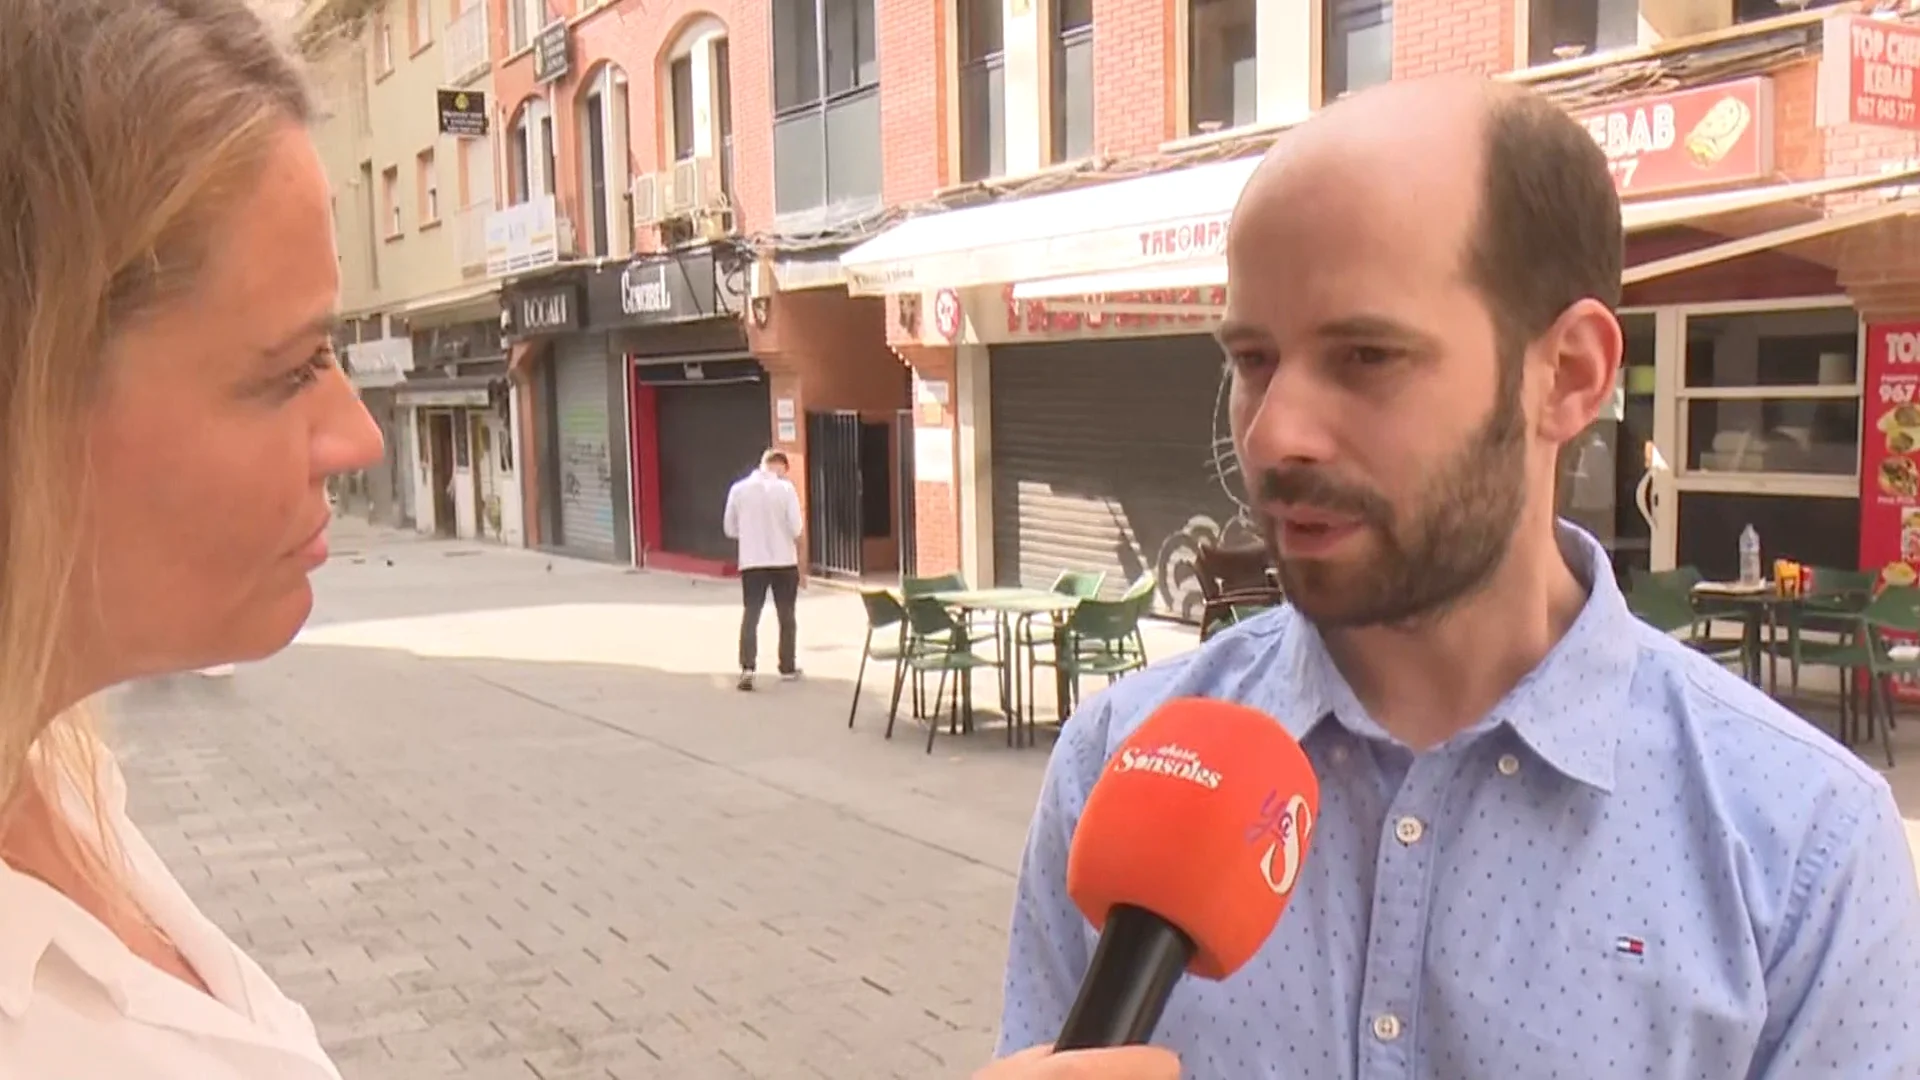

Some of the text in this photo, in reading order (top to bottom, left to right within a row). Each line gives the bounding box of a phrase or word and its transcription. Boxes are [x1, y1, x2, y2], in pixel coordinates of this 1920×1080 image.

[1852, 25, 1884, 61] TOP
[1863, 61, 1914, 99] KEBAB
[1580, 104, 1676, 158] EBAB
[1885, 332, 1920, 364] TO
[1113, 746, 1223, 790] Sonsoles
